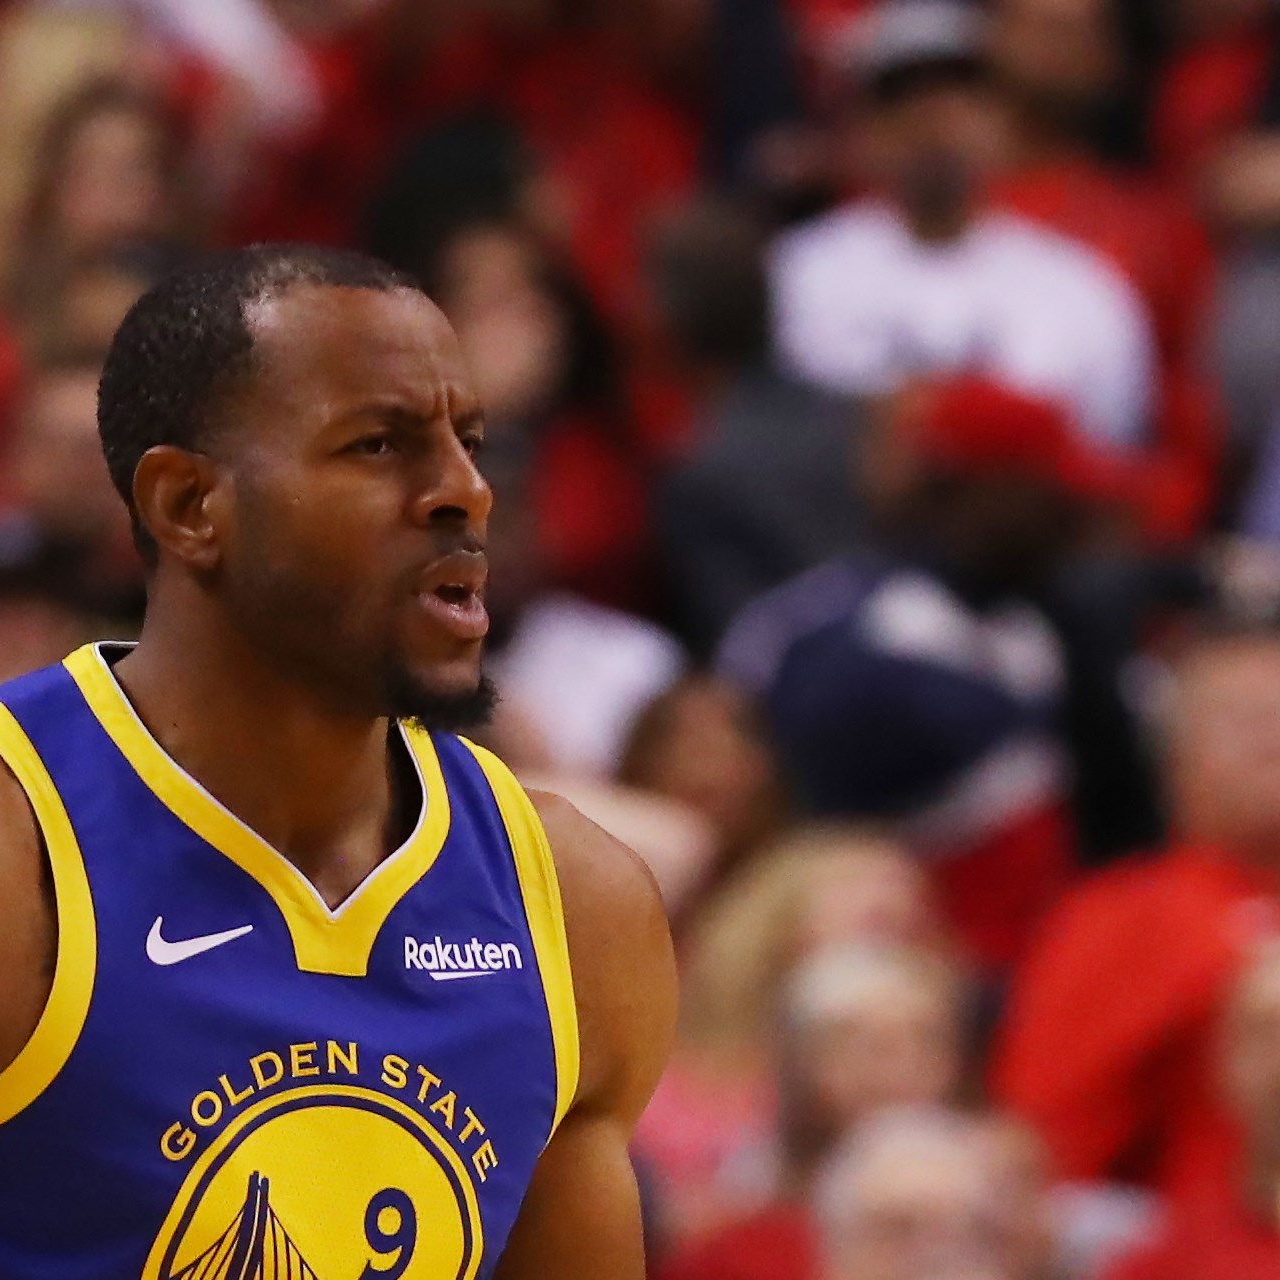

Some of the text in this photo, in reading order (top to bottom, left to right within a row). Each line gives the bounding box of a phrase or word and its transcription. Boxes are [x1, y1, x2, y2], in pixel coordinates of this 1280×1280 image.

[404, 936, 523, 972] Rakuten
[159, 1041, 499, 1183] GOLDEN STATE
